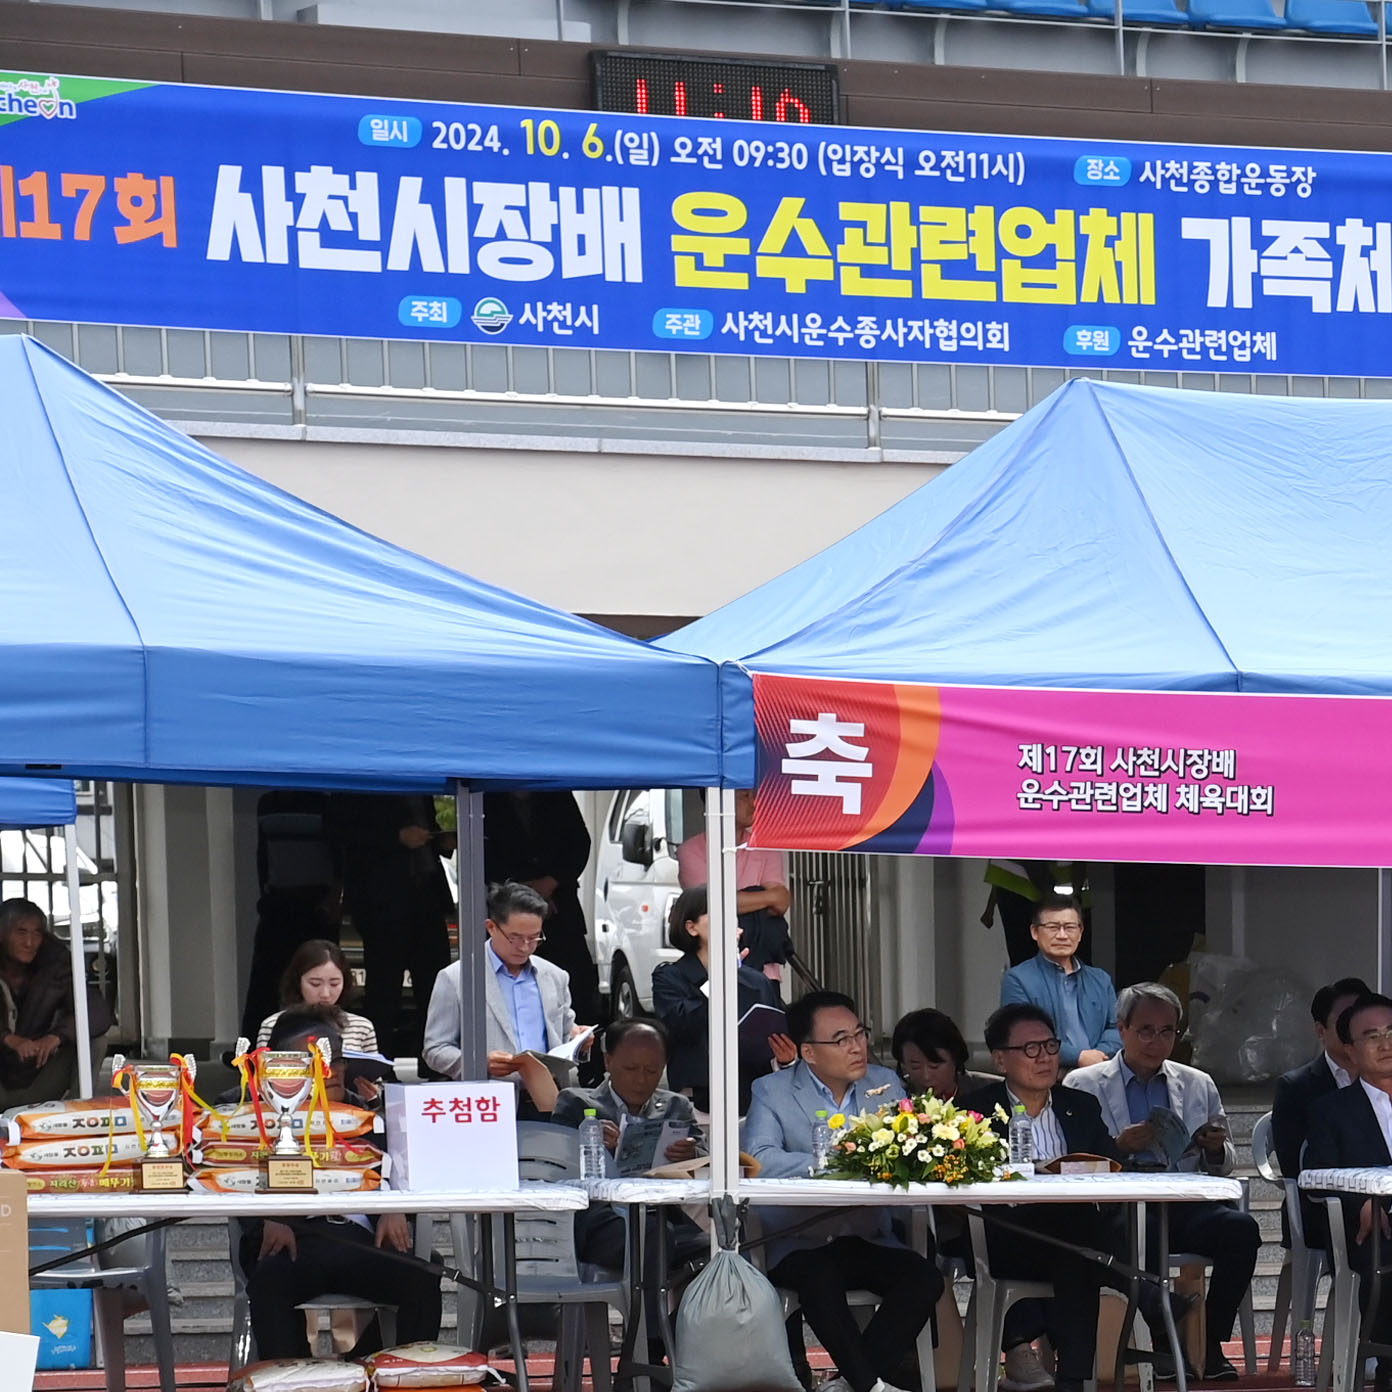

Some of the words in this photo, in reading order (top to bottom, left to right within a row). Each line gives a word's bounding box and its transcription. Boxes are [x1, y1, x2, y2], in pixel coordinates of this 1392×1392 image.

[369, 117, 410, 143] 일시
[431, 120, 510, 156] 2024.
[520, 118, 569, 159] 10.
[670, 136, 724, 170] 오전
[733, 140, 809, 171] 09:30
[817, 141, 905, 180] (입장식
[914, 149, 1026, 186] 오전11시)
[1086, 160, 1120, 181] 장소
[1138, 161, 1317, 198] 사천종합운동장
[0, 164, 178, 248] 17회
[205, 164, 643, 283] 사천시장배
[670, 190, 1157, 306] 운수관련업체
[410, 301, 448, 324] 주최
[518, 301, 600, 336] 사천시
[664, 313, 702, 333] 주관
[721, 310, 1011, 352] 사천시운수종사자협의회
[1075, 329, 1110, 351] 후원
[1127, 326, 1277, 361] 운수관련업체
[781, 712, 873, 815] 축
[1018, 744, 1103, 776] 제17회
[1110, 747, 1237, 780] 사천시장배
[1016, 778, 1169, 813] 운수관련업체
[1175, 784, 1274, 816] 체육대회
[421, 1095, 501, 1124] 추첨함
